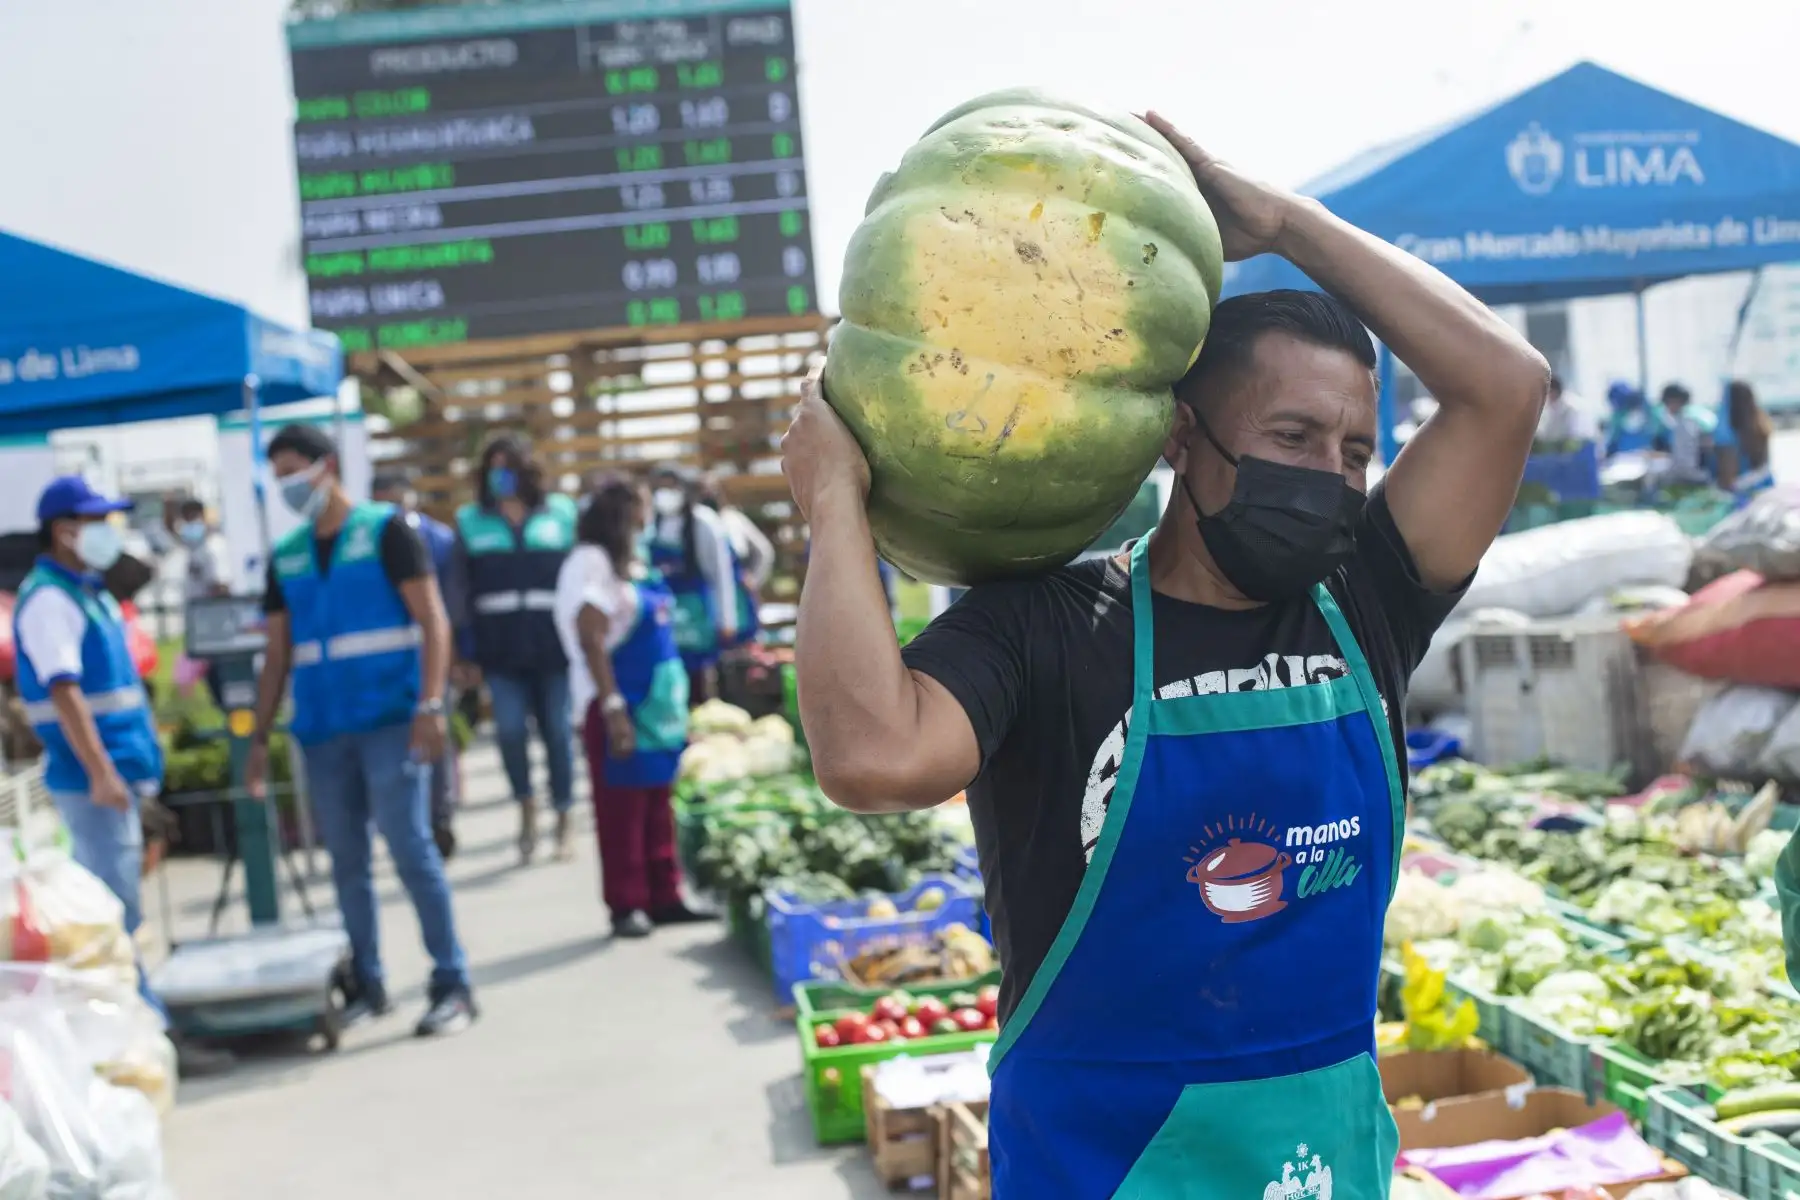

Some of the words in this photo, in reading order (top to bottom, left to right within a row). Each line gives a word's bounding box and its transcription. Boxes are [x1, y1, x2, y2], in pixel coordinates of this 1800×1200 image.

[371, 39, 518, 74] PRODUCTO
[1574, 145, 1704, 186] LIMA
[1464, 226, 1579, 261] Mercado
[1581, 219, 1712, 259] Mayorista
[1714, 214, 1748, 247] de
[1752, 214, 1800, 246] Lim
[17, 347, 58, 381] de
[61, 345, 140, 378] Lima
[1285, 816, 1361, 847] manos
[1295, 851, 1307, 864] a
[1310, 845, 1325, 863] la
[1298, 1160, 1309, 1171] IK
